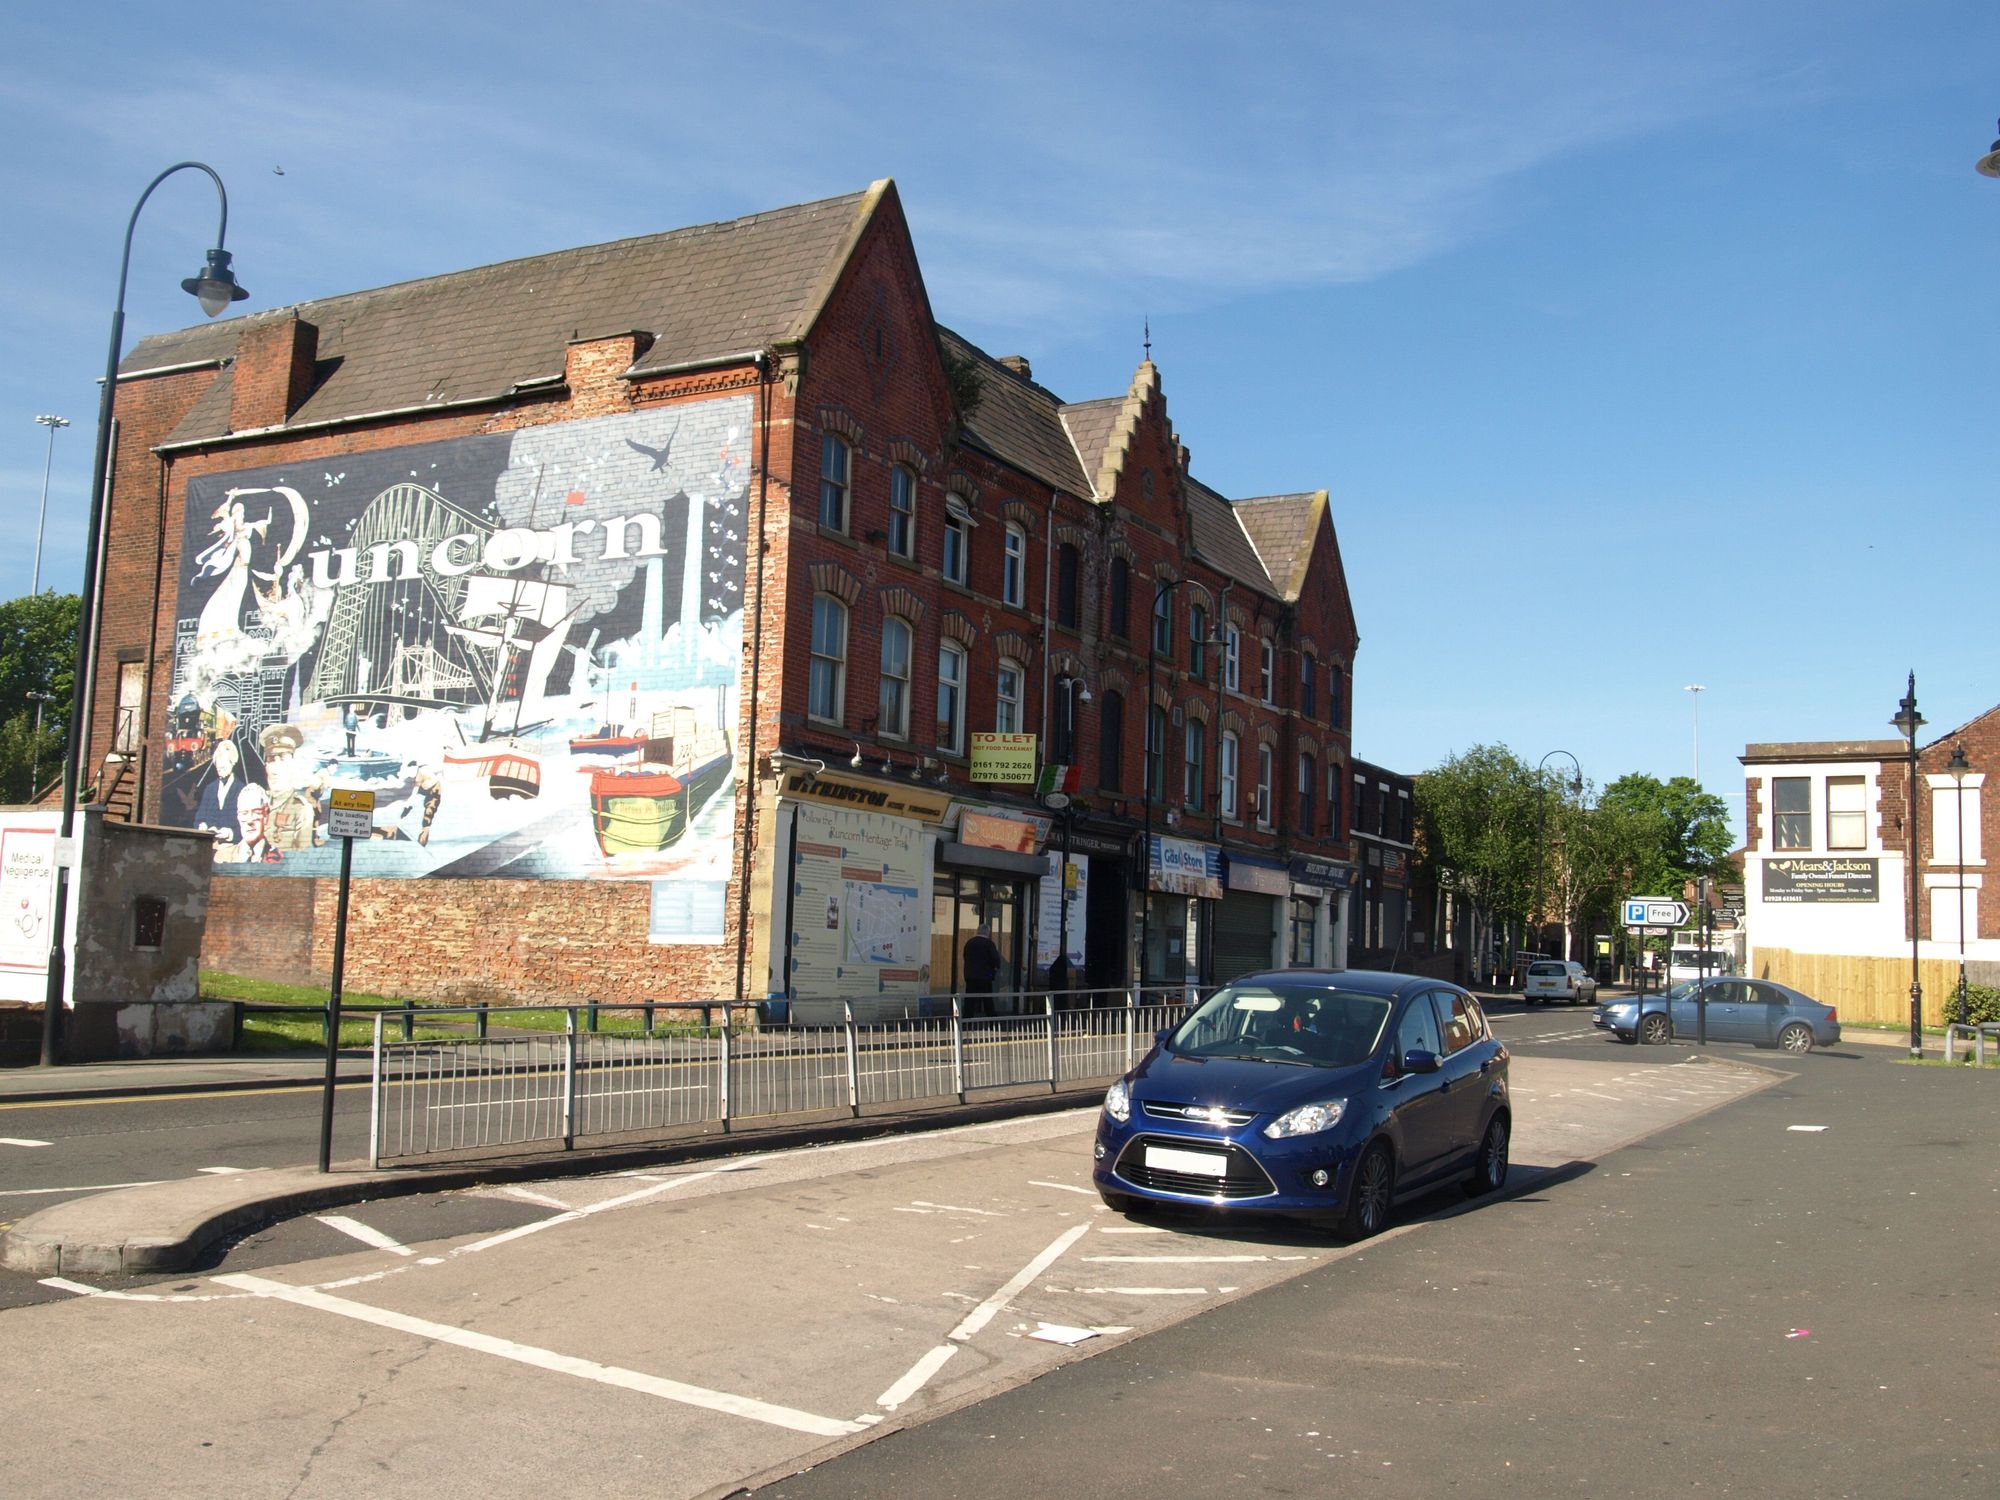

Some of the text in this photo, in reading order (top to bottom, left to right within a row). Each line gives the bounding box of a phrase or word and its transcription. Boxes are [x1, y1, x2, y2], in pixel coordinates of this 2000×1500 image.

[194, 485, 668, 628] Runcorn
[974, 734, 1034, 743] TO LET
[345, 812, 369, 820] loading
[862, 831, 893, 851] Heritage
[12, 852, 44, 864] Medical
[1164, 848, 1178, 864] Gas
[1183, 852, 1203, 868] Store
[4, 866, 49, 879] Negligence
[1631, 905, 1672, 920] P Free
